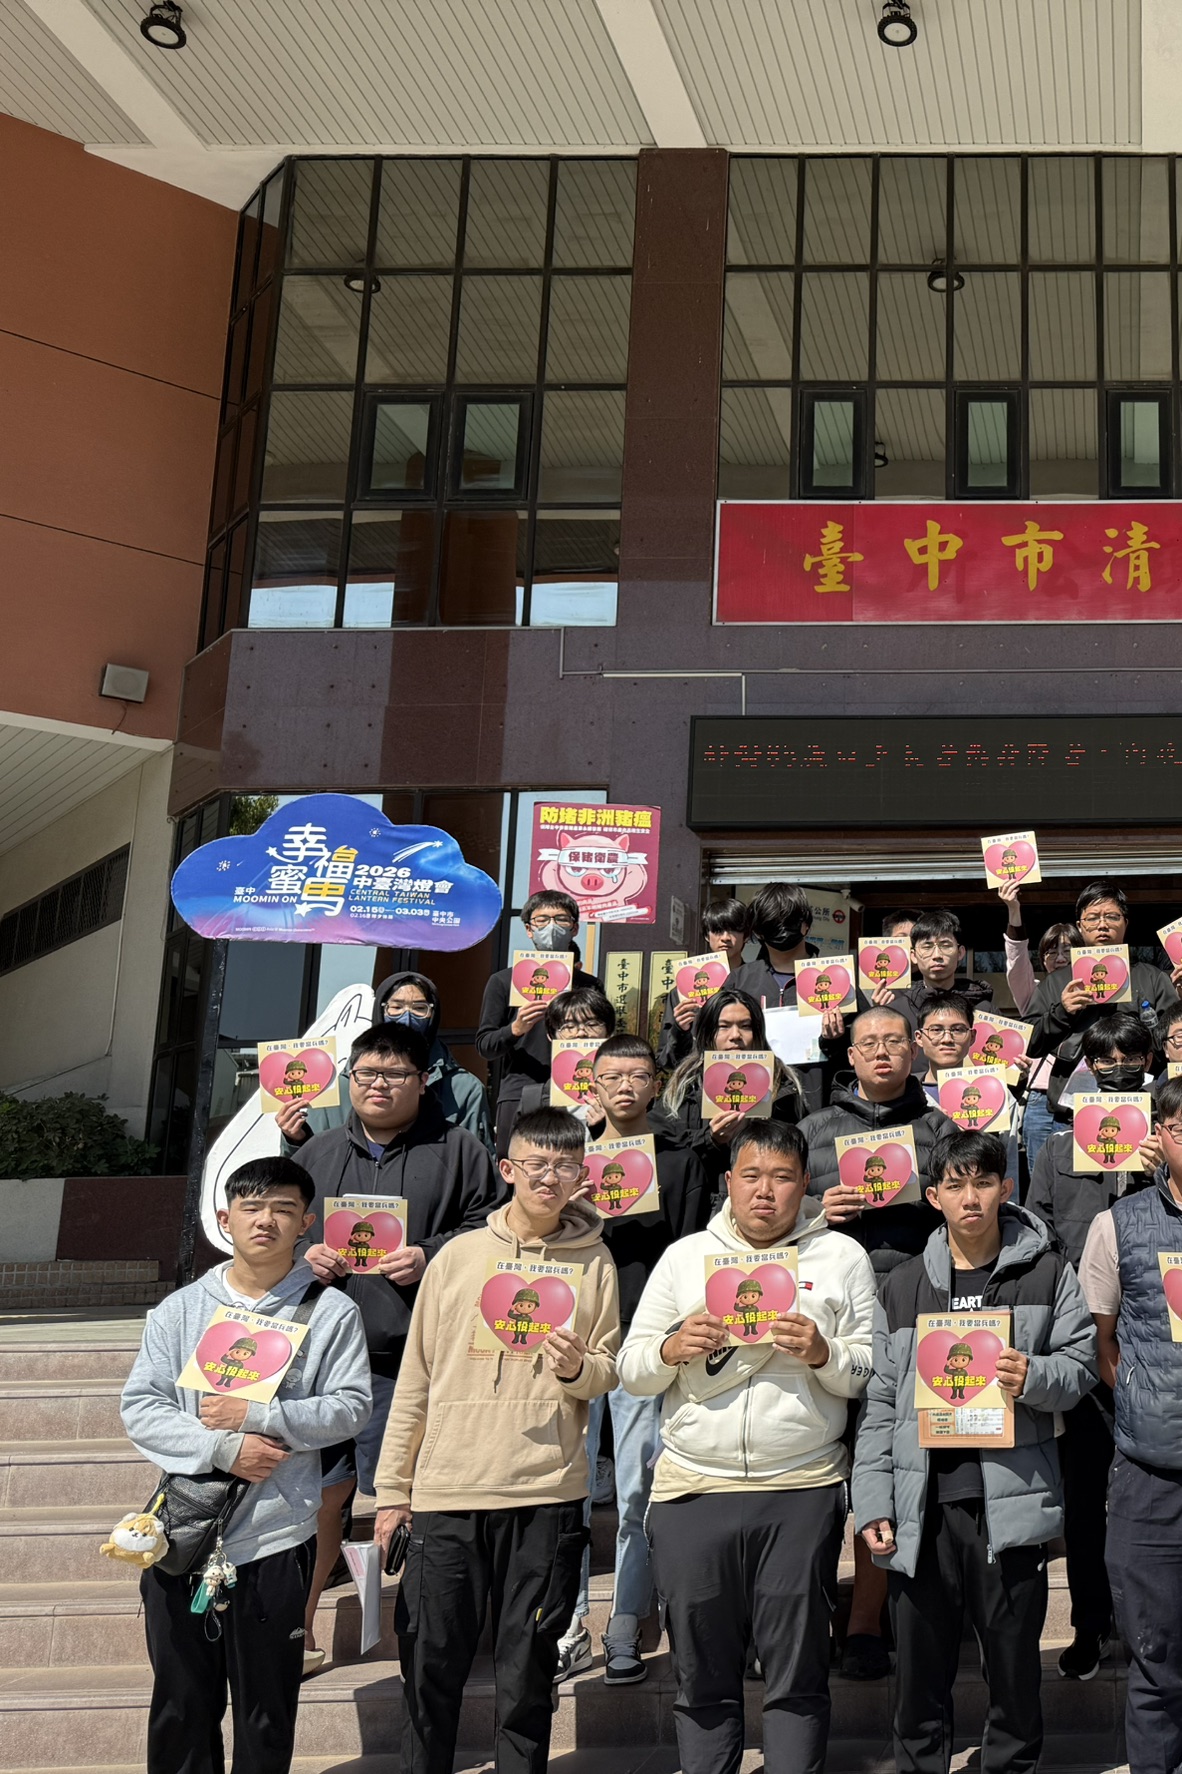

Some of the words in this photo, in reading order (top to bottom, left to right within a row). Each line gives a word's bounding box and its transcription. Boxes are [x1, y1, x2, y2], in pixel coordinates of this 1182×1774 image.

[540, 806, 652, 828] 防堵非洲豬瘟
[355, 864, 412, 878] 2026
[234, 886, 256, 895] 臺中
[353, 876, 454, 894] 中臺灣燈會
[348, 895, 389, 903] LANTERN
[391, 897, 436, 906] FESTIVAL
[1087, 1143, 1133, 1154] 安心役起來
[338, 1248, 387, 1257] 安心役起來
[722, 1309, 779, 1325] 安心役起來
[494, 1319, 552, 1334] 安心役起來
[203, 1361, 261, 1382] 安心役起來
[932, 1375, 987, 1387] 安心役起來
